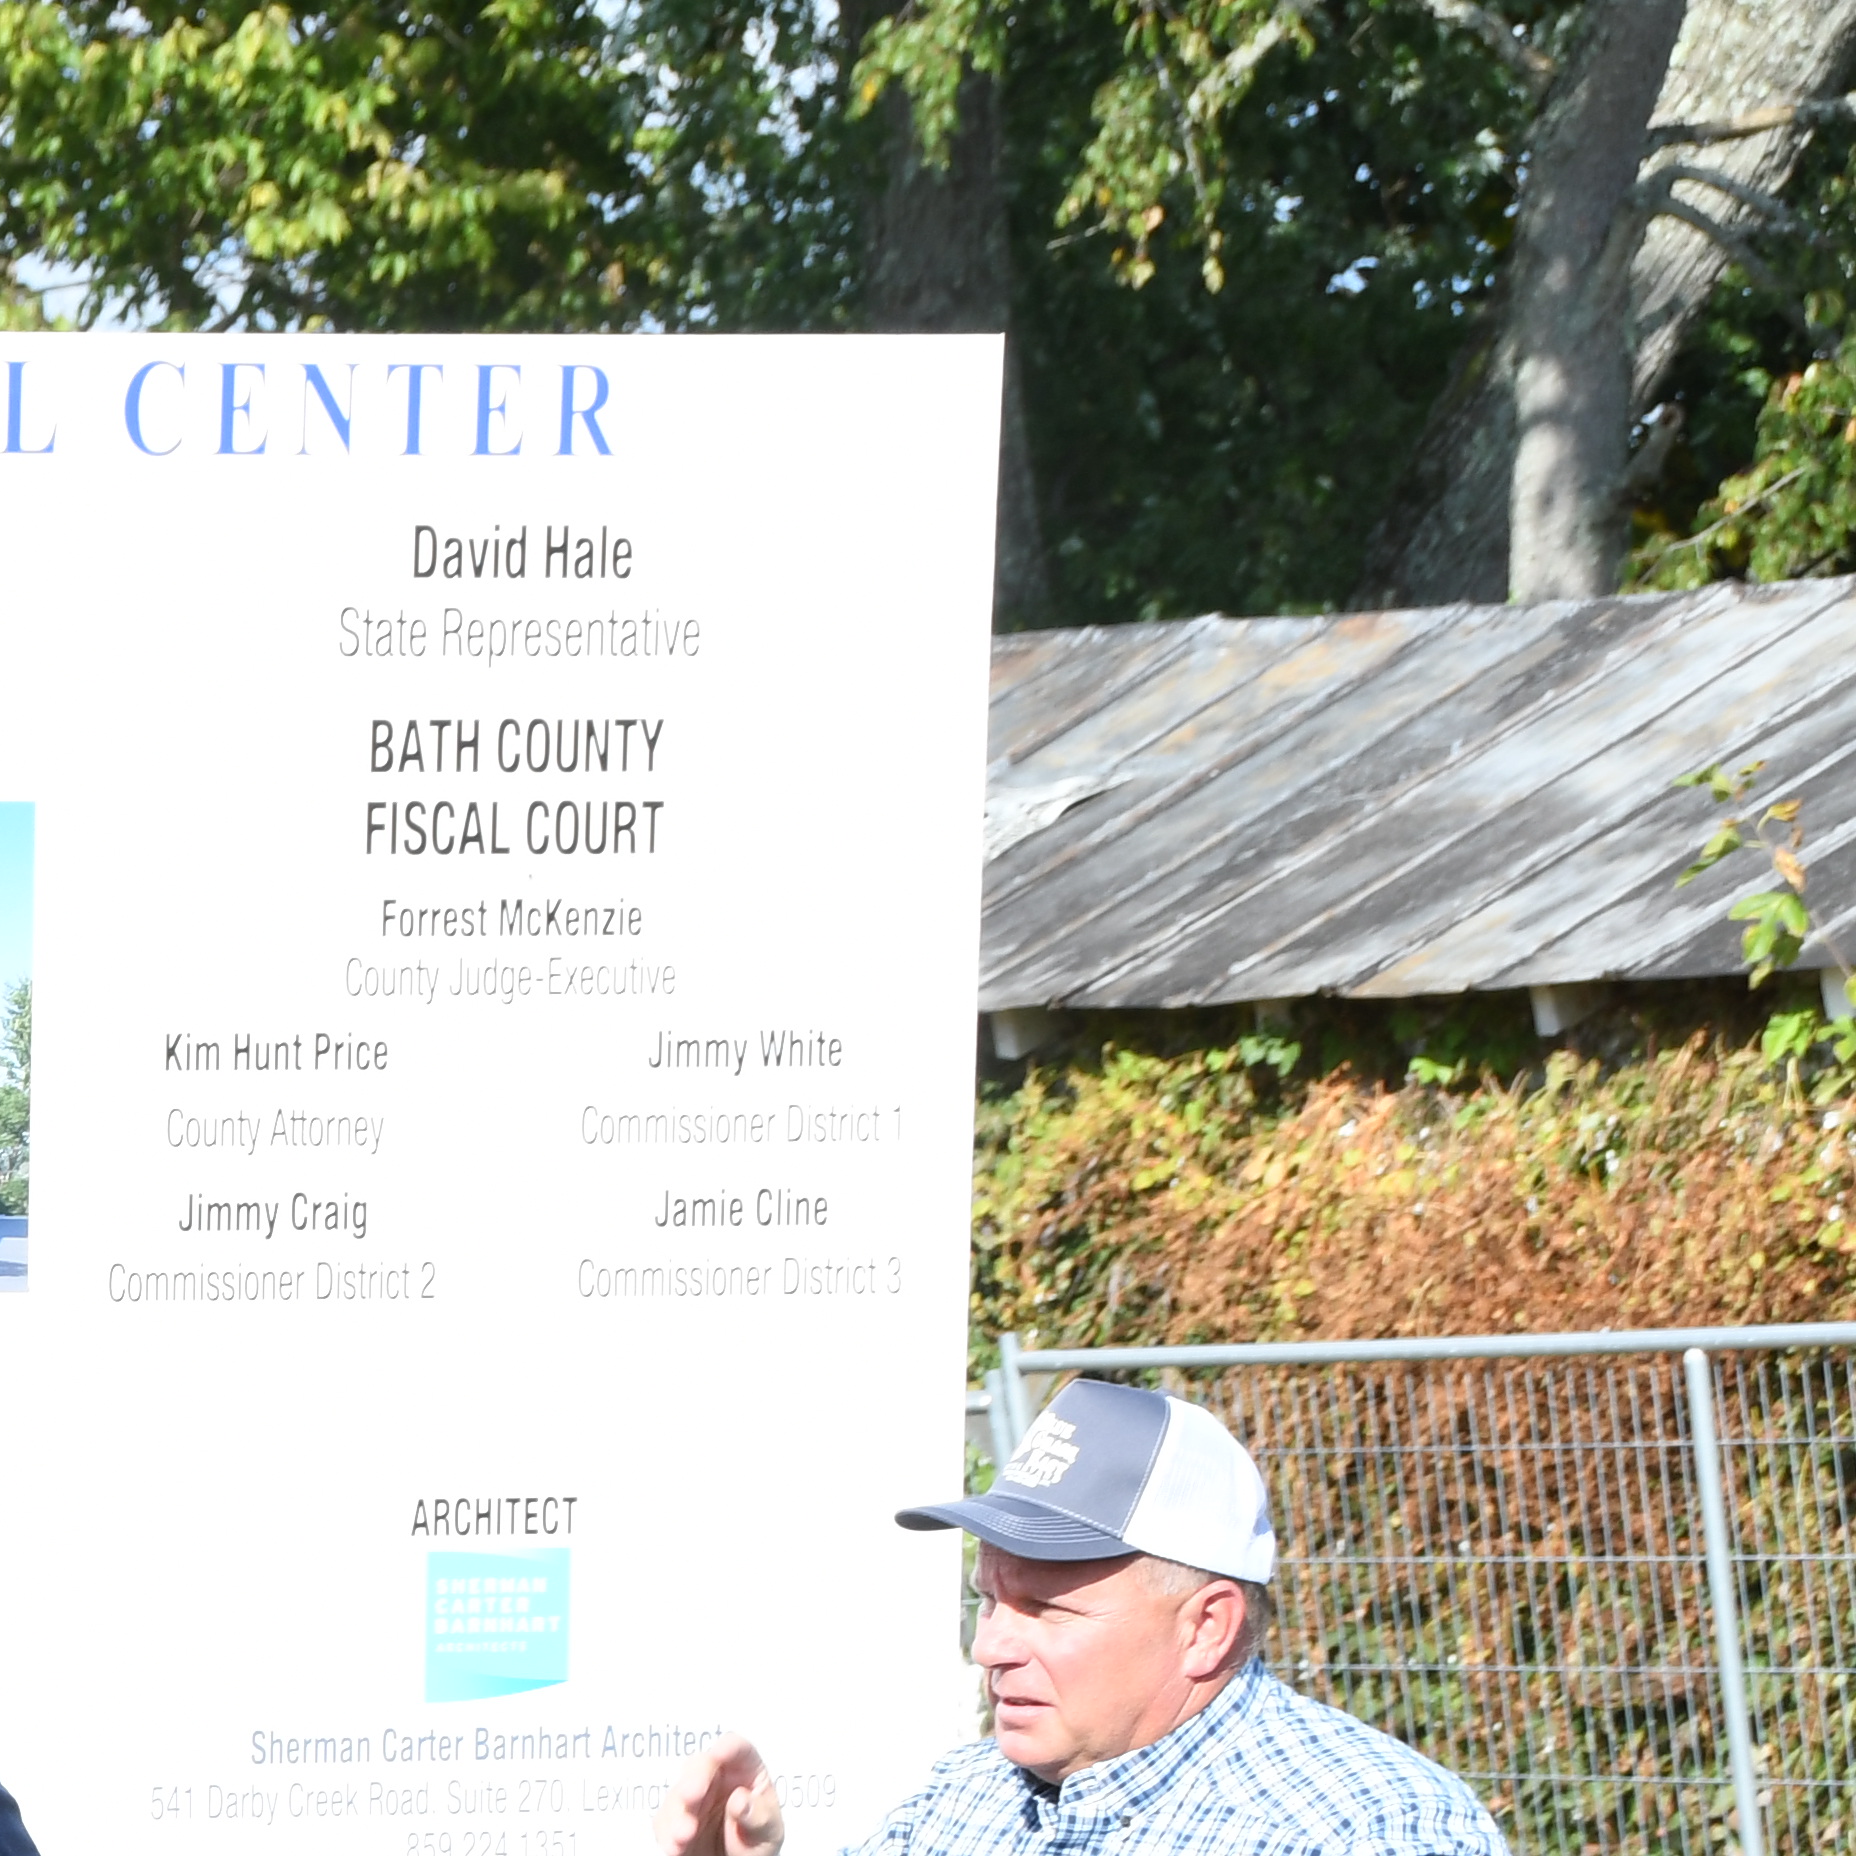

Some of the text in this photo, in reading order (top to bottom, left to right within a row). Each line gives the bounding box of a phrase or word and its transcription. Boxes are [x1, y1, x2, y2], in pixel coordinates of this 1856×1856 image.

[123, 360, 615, 457] CENTER
[412, 523, 633, 580] David Hale
[339, 606, 701, 669] State Representative
[370, 717, 665, 774] BATH COUNTY
[365, 799, 665, 856] FISCAL COURT
[382, 897, 643, 938] Forrest McKenzie
[345, 956, 676, 1006] County Judge-Executive
[165, 1031, 389, 1072] Kim Hunt Price
[648, 1028, 843, 1077] Jimmy White
[167, 1108, 385, 1156] County Attorney
[581, 1105, 776, 1145] Commissioner
[787, 1104, 881, 1143] District
[178, 1191, 368, 1241] Jimmy Craig
[654, 1187, 828, 1228] Jamie Cline
[108, 1261, 436, 1303] Commissioner District 2
[578, 1256, 902, 1298] Commissioner District 3
[410, 1496, 579, 1537] ARCHITECT
[251, 1730, 370, 1765] Sherman
[382, 1727, 464, 1763] Carter
[474, 1726, 592, 1761] Barnhart
[151, 1786, 194, 1821] 541
[208, 1784, 278, 1826] Darby
[289, 1783, 360, 1819] Creek
[448, 1779, 508, 1816] Suite
